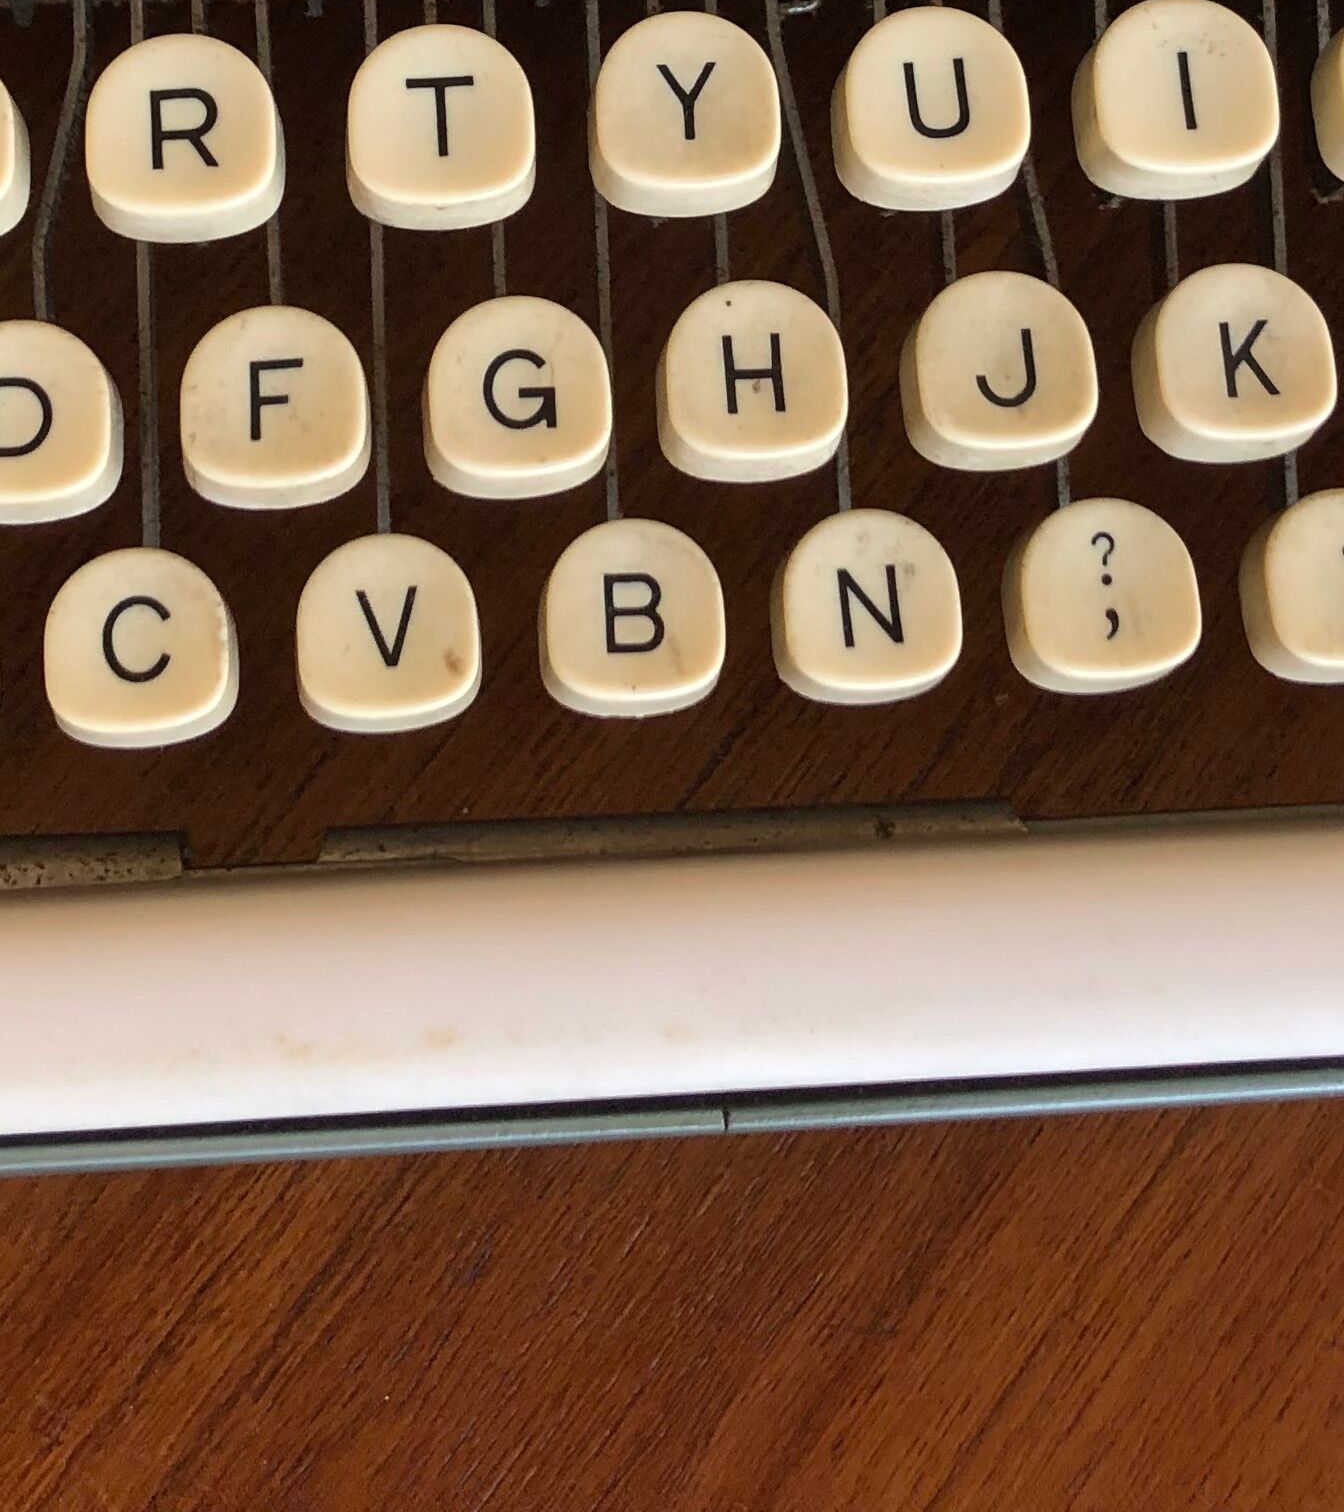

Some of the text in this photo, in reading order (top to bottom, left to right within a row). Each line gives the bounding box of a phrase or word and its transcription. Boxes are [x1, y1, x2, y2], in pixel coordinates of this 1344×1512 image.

[149, 87, 219, 170] R
[405, 75, 475, 158] T
[656, 61, 717, 141] Y
[903, 57, 971, 139] U
[1177, 51, 1198, 130] I
[249, 358, 304, 441] F
[482, 348, 558, 430] G
[721, 332, 786, 415] H
[975, 328, 1037, 408] J
[1219, 319, 1281, 398] K
[102, 595, 171, 684] C
[355, 585, 418, 668] V
[603, 573, 665, 654] B
[836, 564, 905, 648] N
